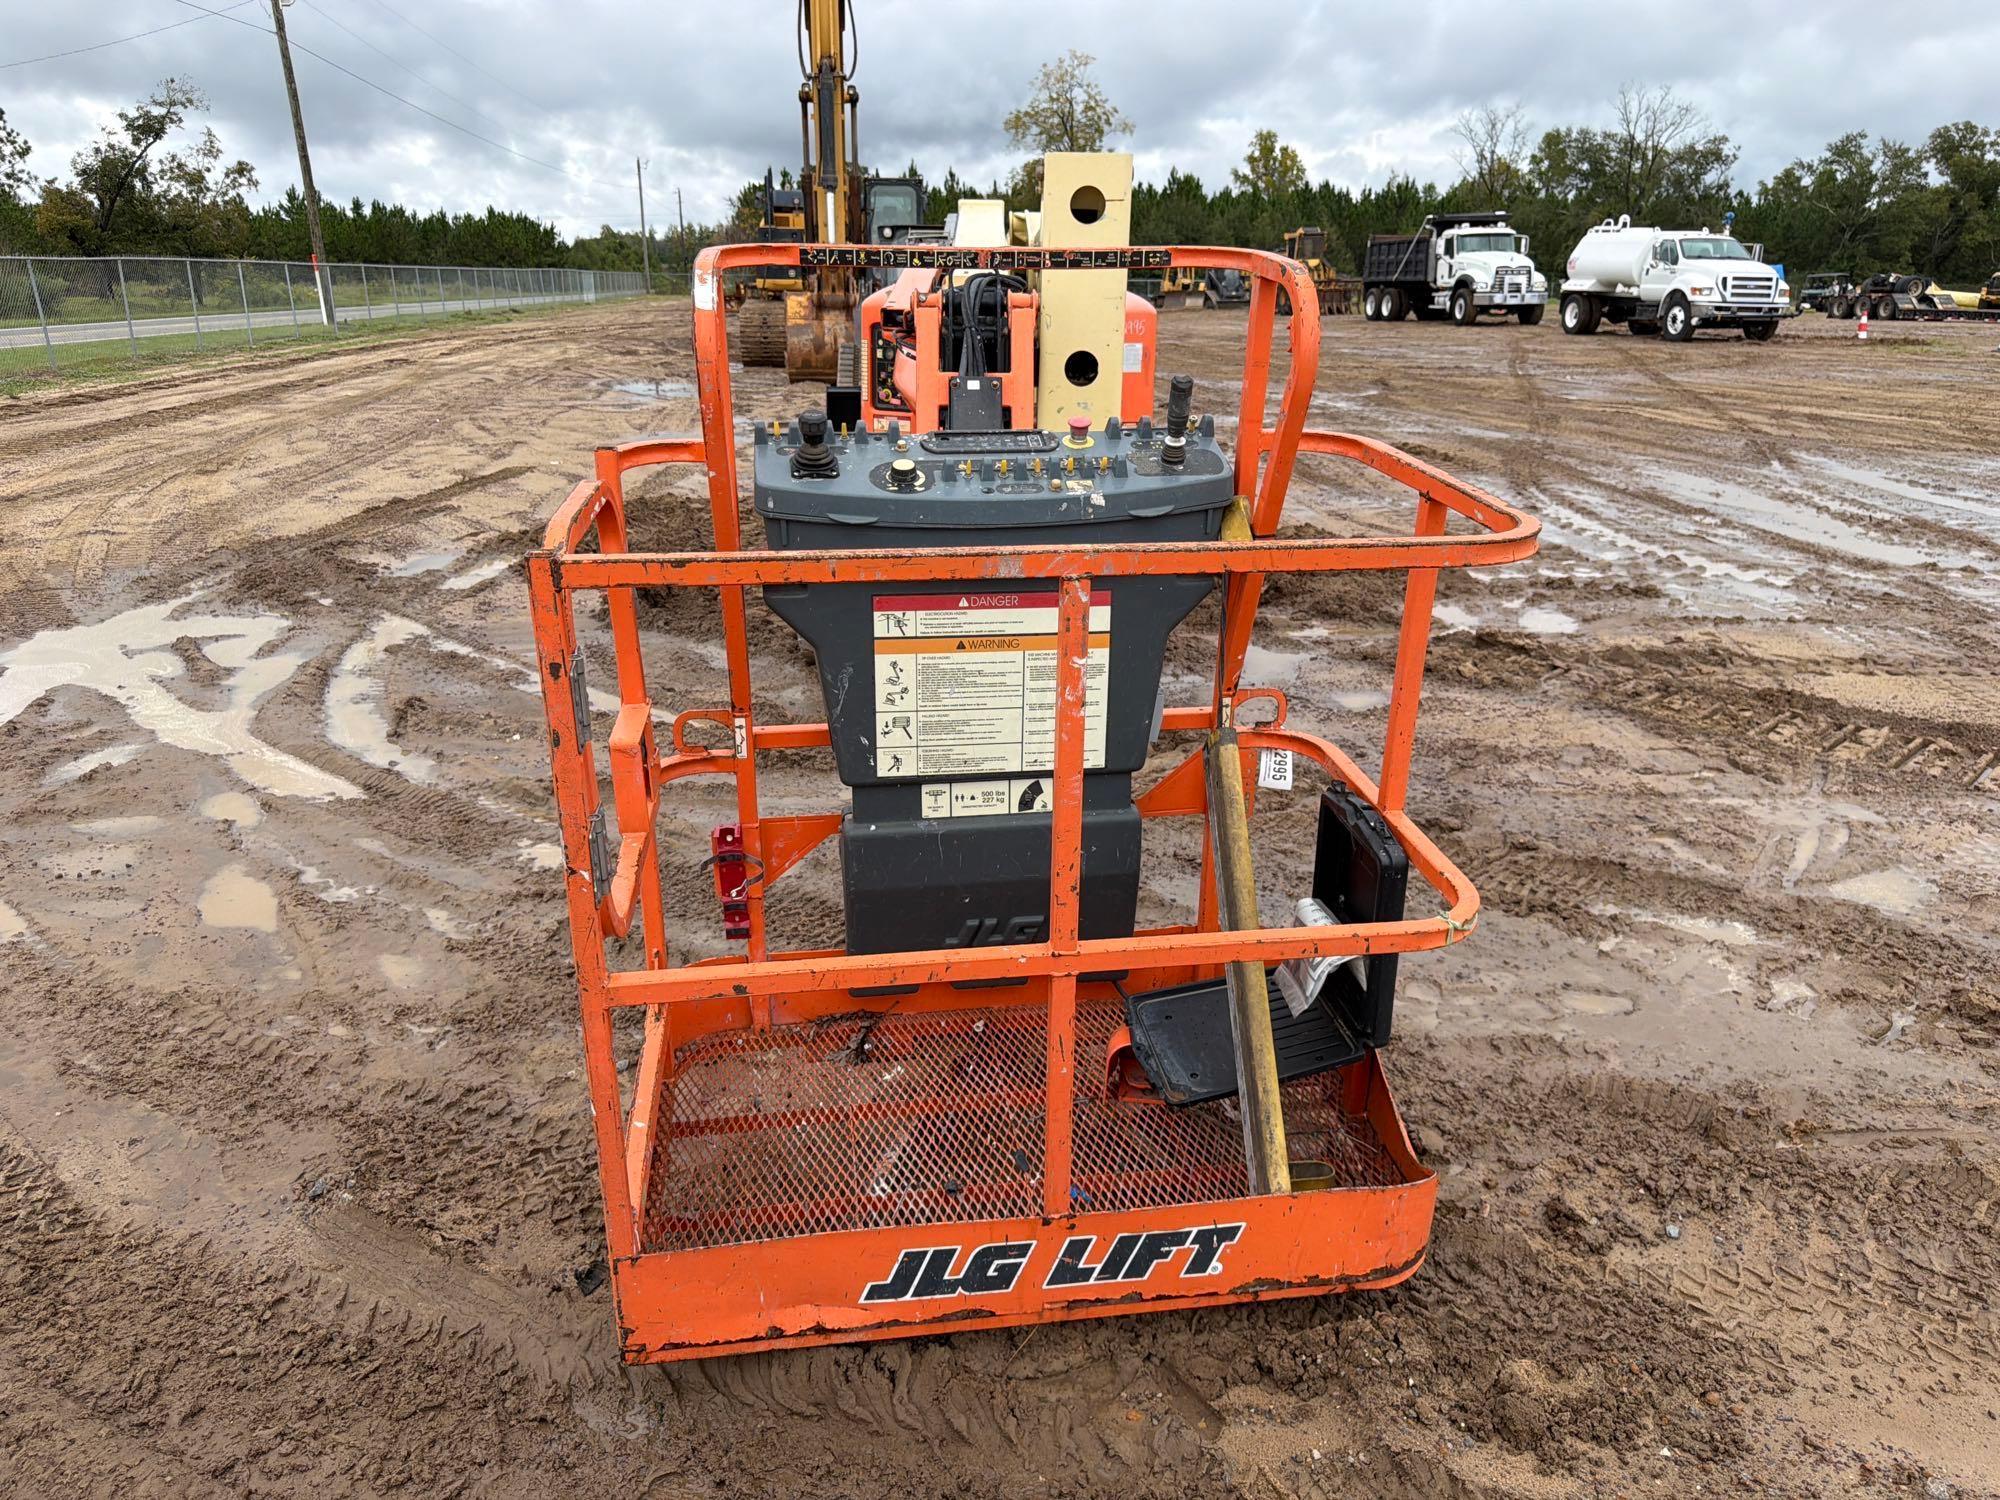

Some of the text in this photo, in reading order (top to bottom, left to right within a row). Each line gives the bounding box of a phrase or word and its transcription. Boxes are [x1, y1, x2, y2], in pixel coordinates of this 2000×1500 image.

[1125, 319, 1146, 336] 995
[970, 595, 1019, 607] DANGER
[967, 638, 1020, 650] WARNING
[944, 915, 1045, 944] JLG
[859, 1239, 1037, 1304] JLG
